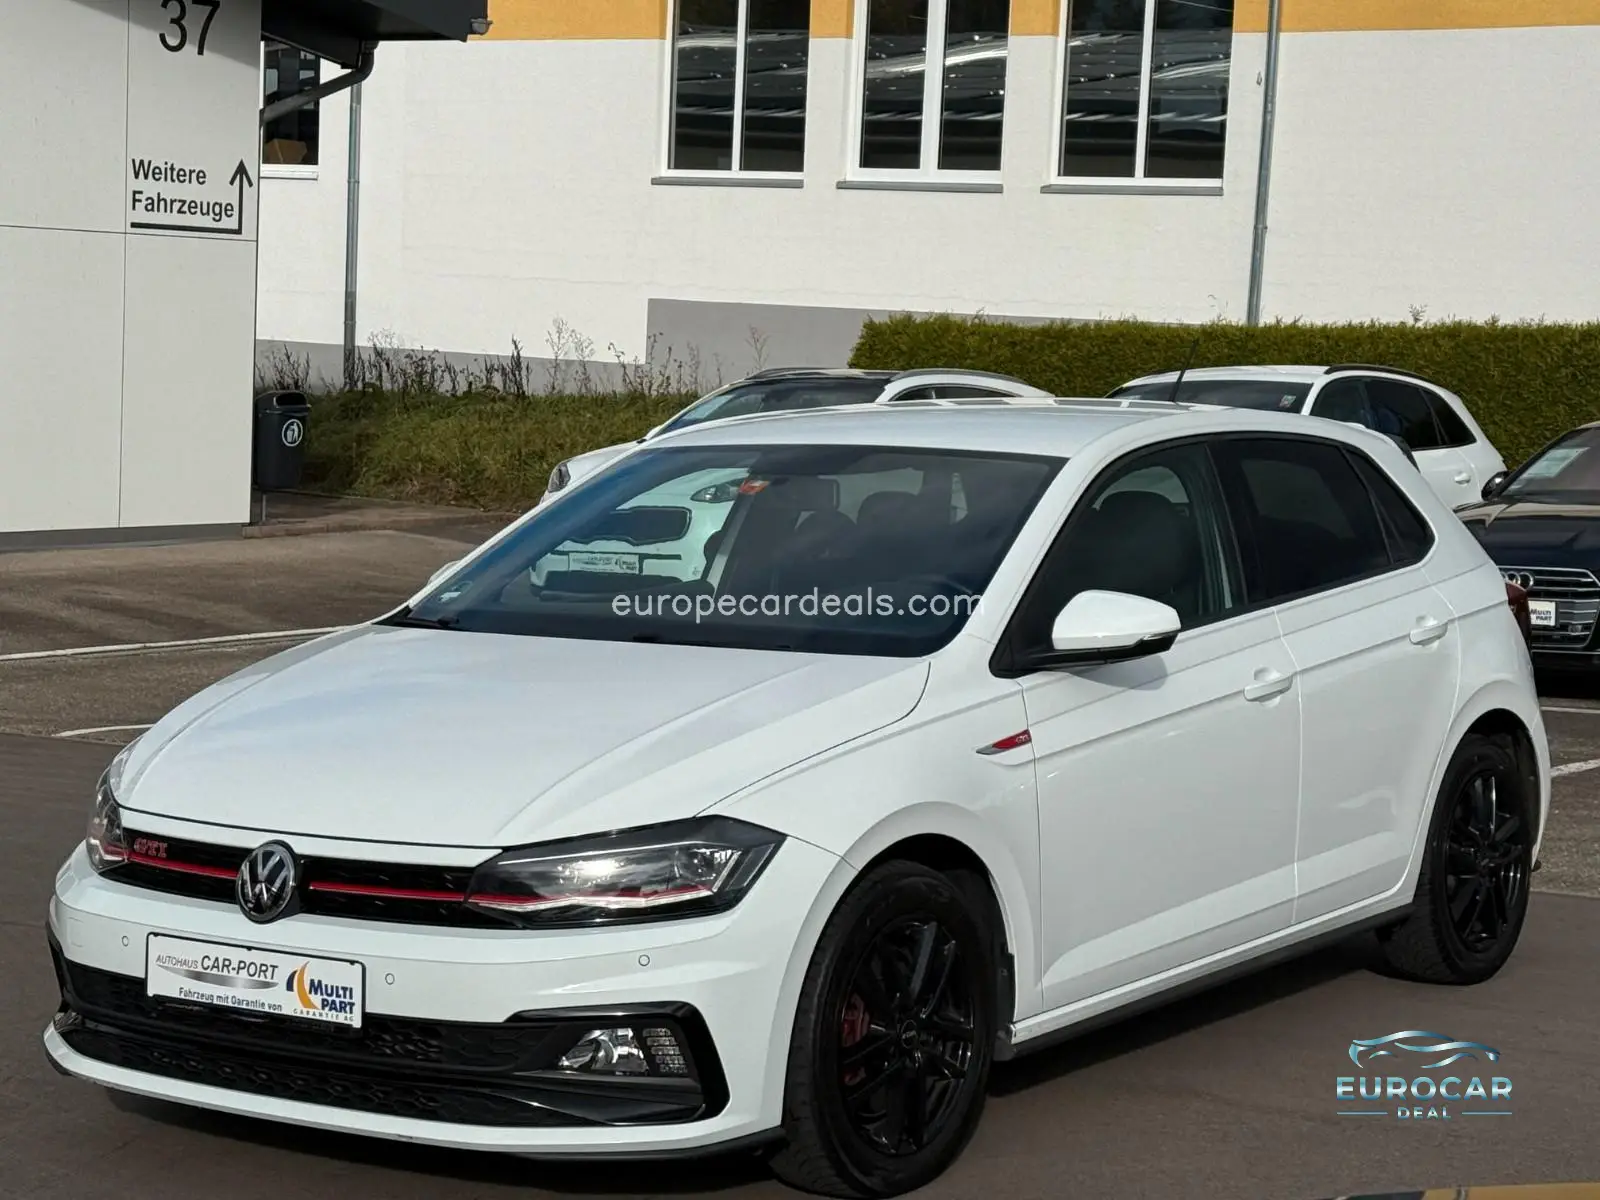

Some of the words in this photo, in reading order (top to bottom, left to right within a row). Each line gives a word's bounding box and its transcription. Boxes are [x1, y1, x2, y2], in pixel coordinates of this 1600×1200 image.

[159, 0, 221, 56] 37
[131, 158, 207, 186] Weitere
[131, 189, 235, 223] Fahrzeuge
[134, 837, 168, 858] GTI
[155, 954, 199, 970] AUTOHAUS
[201, 955, 279, 981] CAR-PORT
[179, 987, 215, 1003] Fahrzeug
[216, 993, 230, 1004] mit
[231, 995, 266, 1010] Garantie
[267, 1002, 283, 1012] von
[308, 979, 354, 1000] MULTI
[293, 1008, 339, 1021] GARANTIE
[321, 998, 355, 1014] PART
